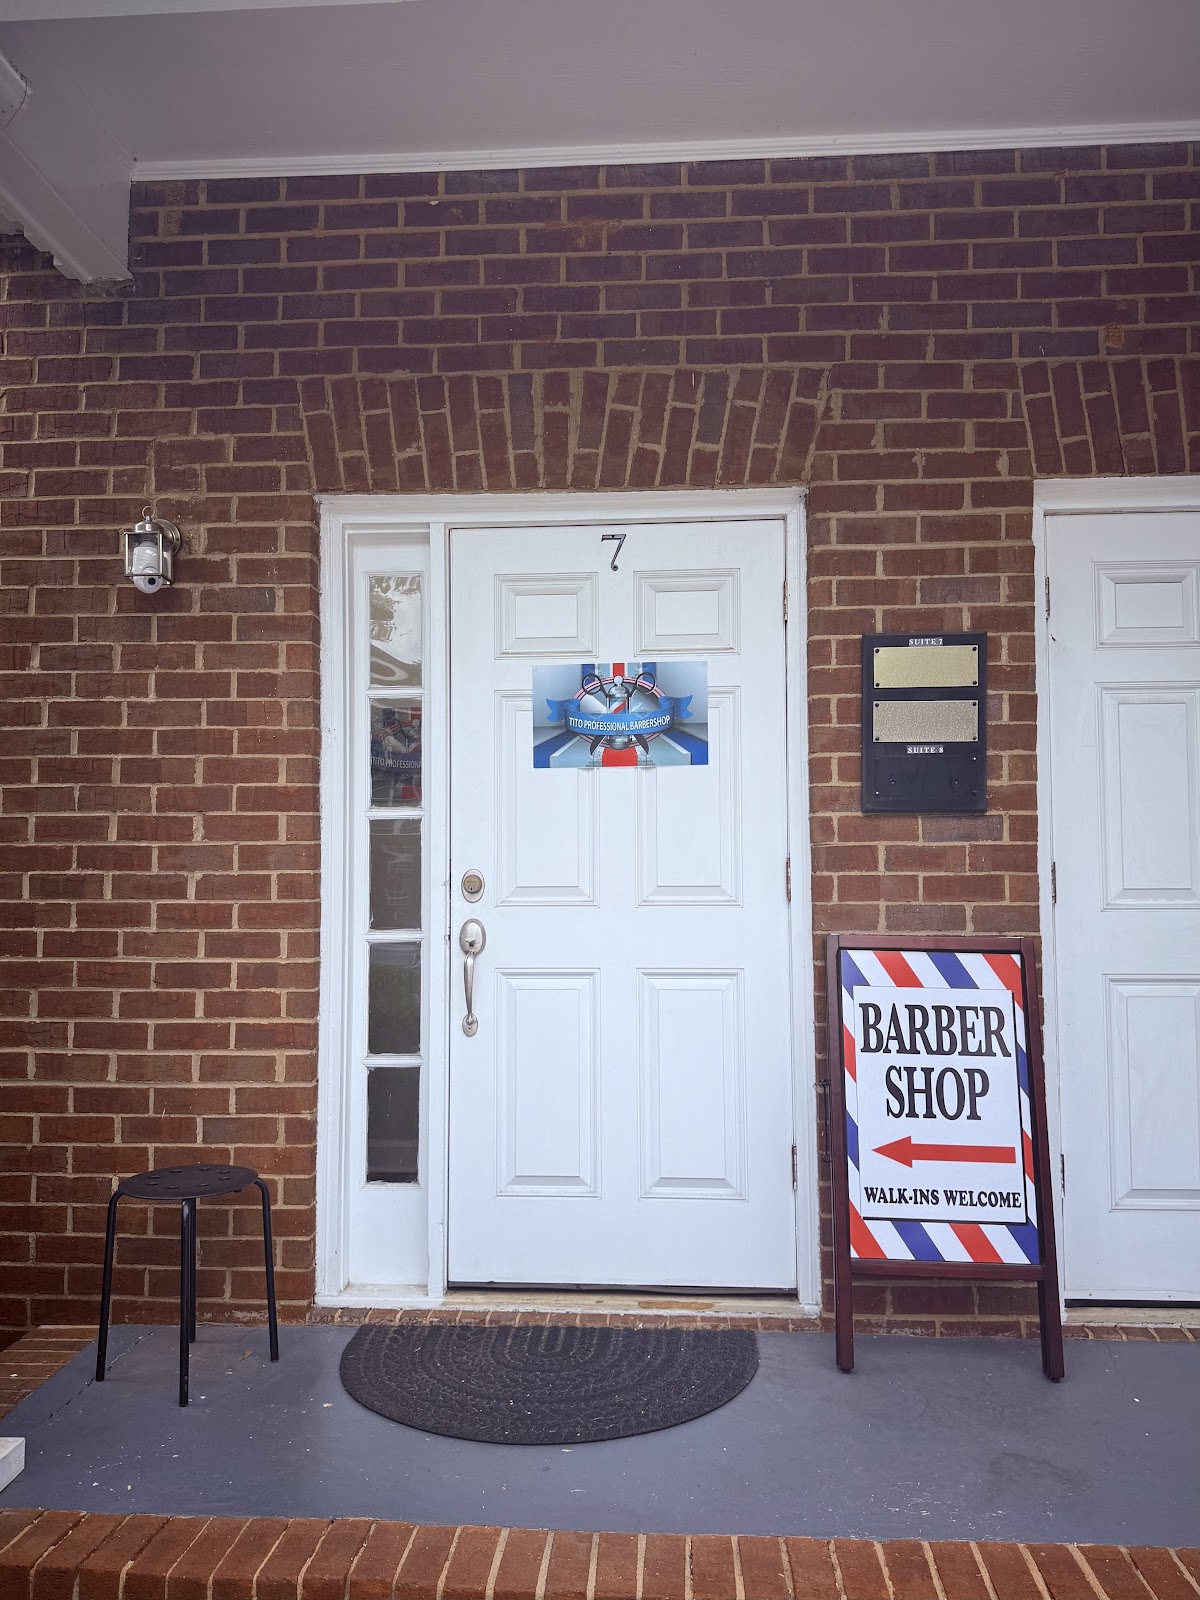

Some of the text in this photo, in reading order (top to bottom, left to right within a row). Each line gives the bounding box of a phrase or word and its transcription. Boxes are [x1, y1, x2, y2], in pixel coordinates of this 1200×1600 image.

[601, 534, 626, 571] 7
[569, 715, 670, 731] TITO PROFESSIONAL BARBERSHOP
[859, 1002, 1011, 1057] BARBER
[885, 1065, 989, 1120] SHOP
[864, 1187, 1021, 1208] WALK-INS WELCOME
